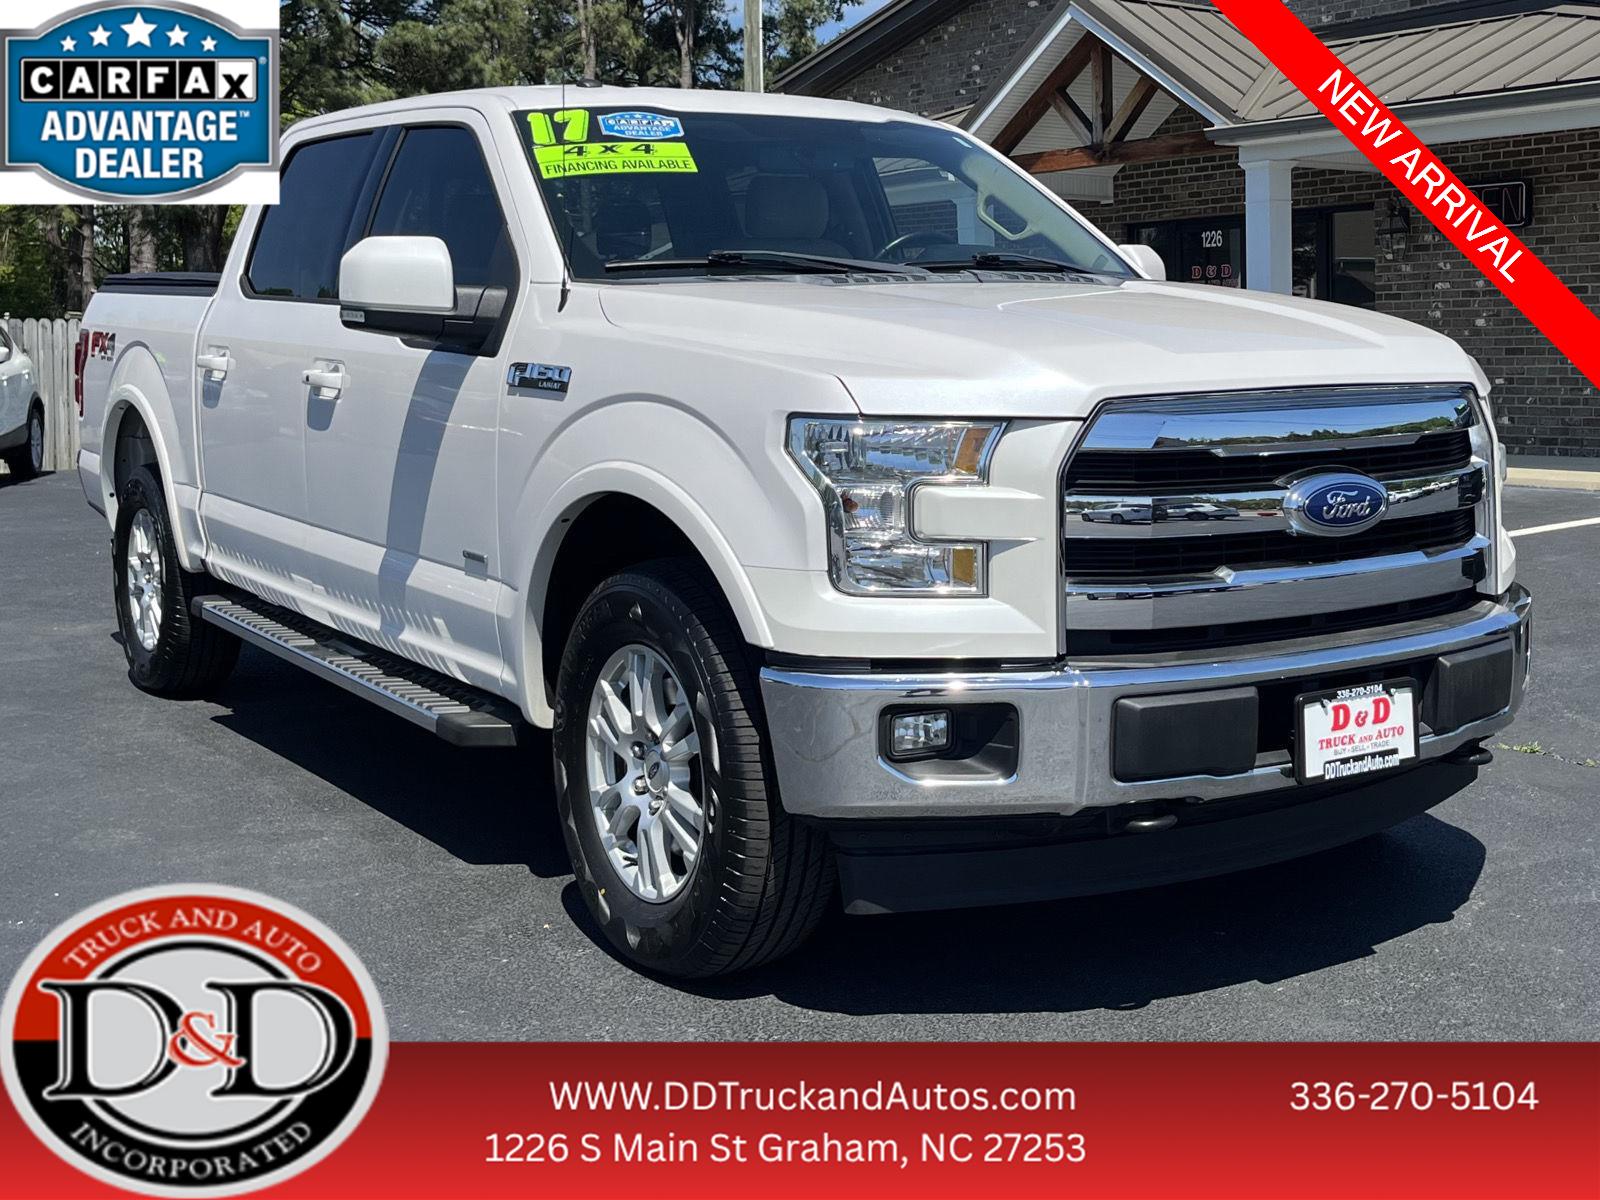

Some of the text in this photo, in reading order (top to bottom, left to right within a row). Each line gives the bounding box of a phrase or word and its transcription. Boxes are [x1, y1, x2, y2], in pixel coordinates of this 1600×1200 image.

[527, 109, 590, 145] 17
[545, 159, 692, 175] FINANCING AVAILABLE
[1201, 230, 1223, 248] 1226
[1191, 264, 1232, 279] D & D
[91, 331, 116, 357] FX4
[538, 381, 561, 389] LARIAT
[1322, 490, 1371, 520] Ford
[1336, 683, 1383, 699] 336-270-5104
[1331, 697, 1391, 732] D & D
[1318, 725, 1405, 750] TRUCK AND AUTO
[1333, 740, 1390, 756] BUY SELL TRADE
[1324, 753, 1400, 780] DDTruckandAuto.com
